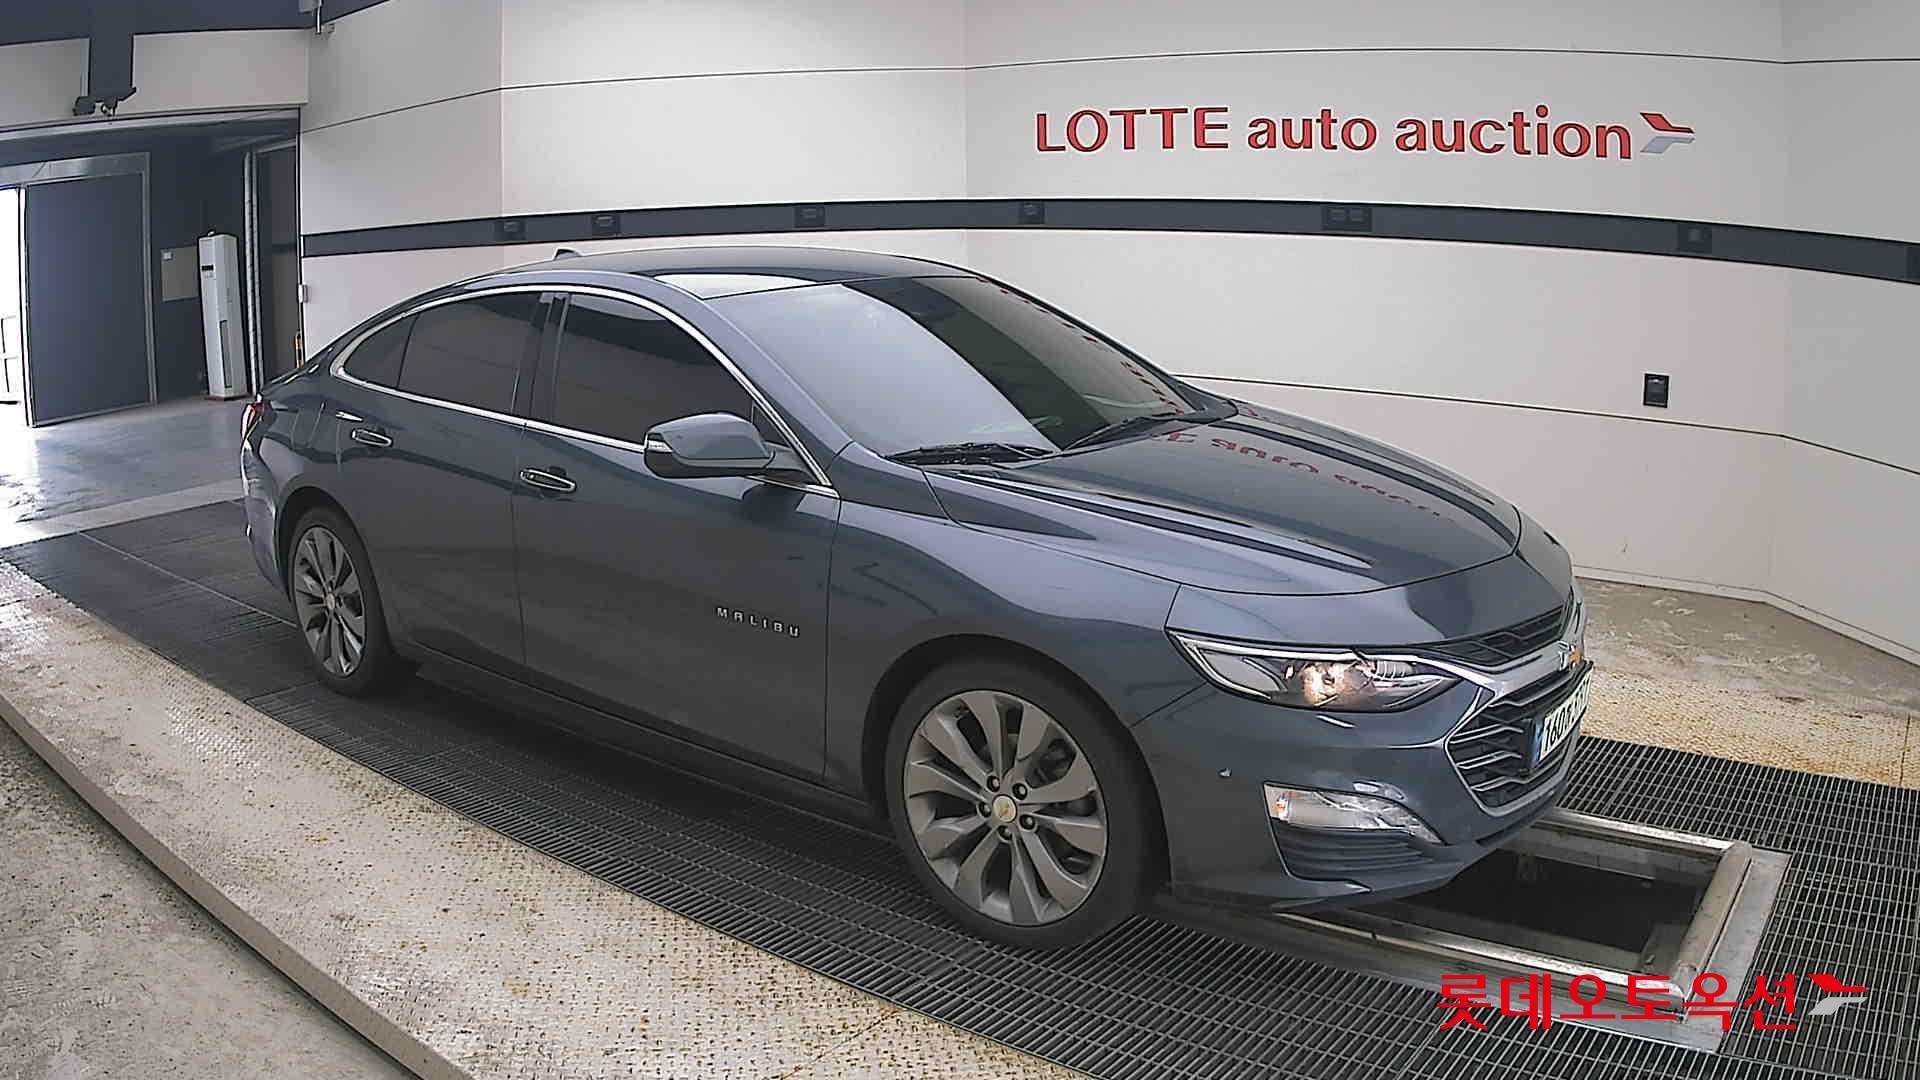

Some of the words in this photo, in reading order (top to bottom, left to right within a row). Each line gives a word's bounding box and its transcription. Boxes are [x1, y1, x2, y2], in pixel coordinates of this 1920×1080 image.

[1036, 107, 1229, 152] LOTTE
[1247, 108, 1377, 151] auto
[1395, 104, 1632, 160] auction
[716, 606, 799, 637] MALIBU
